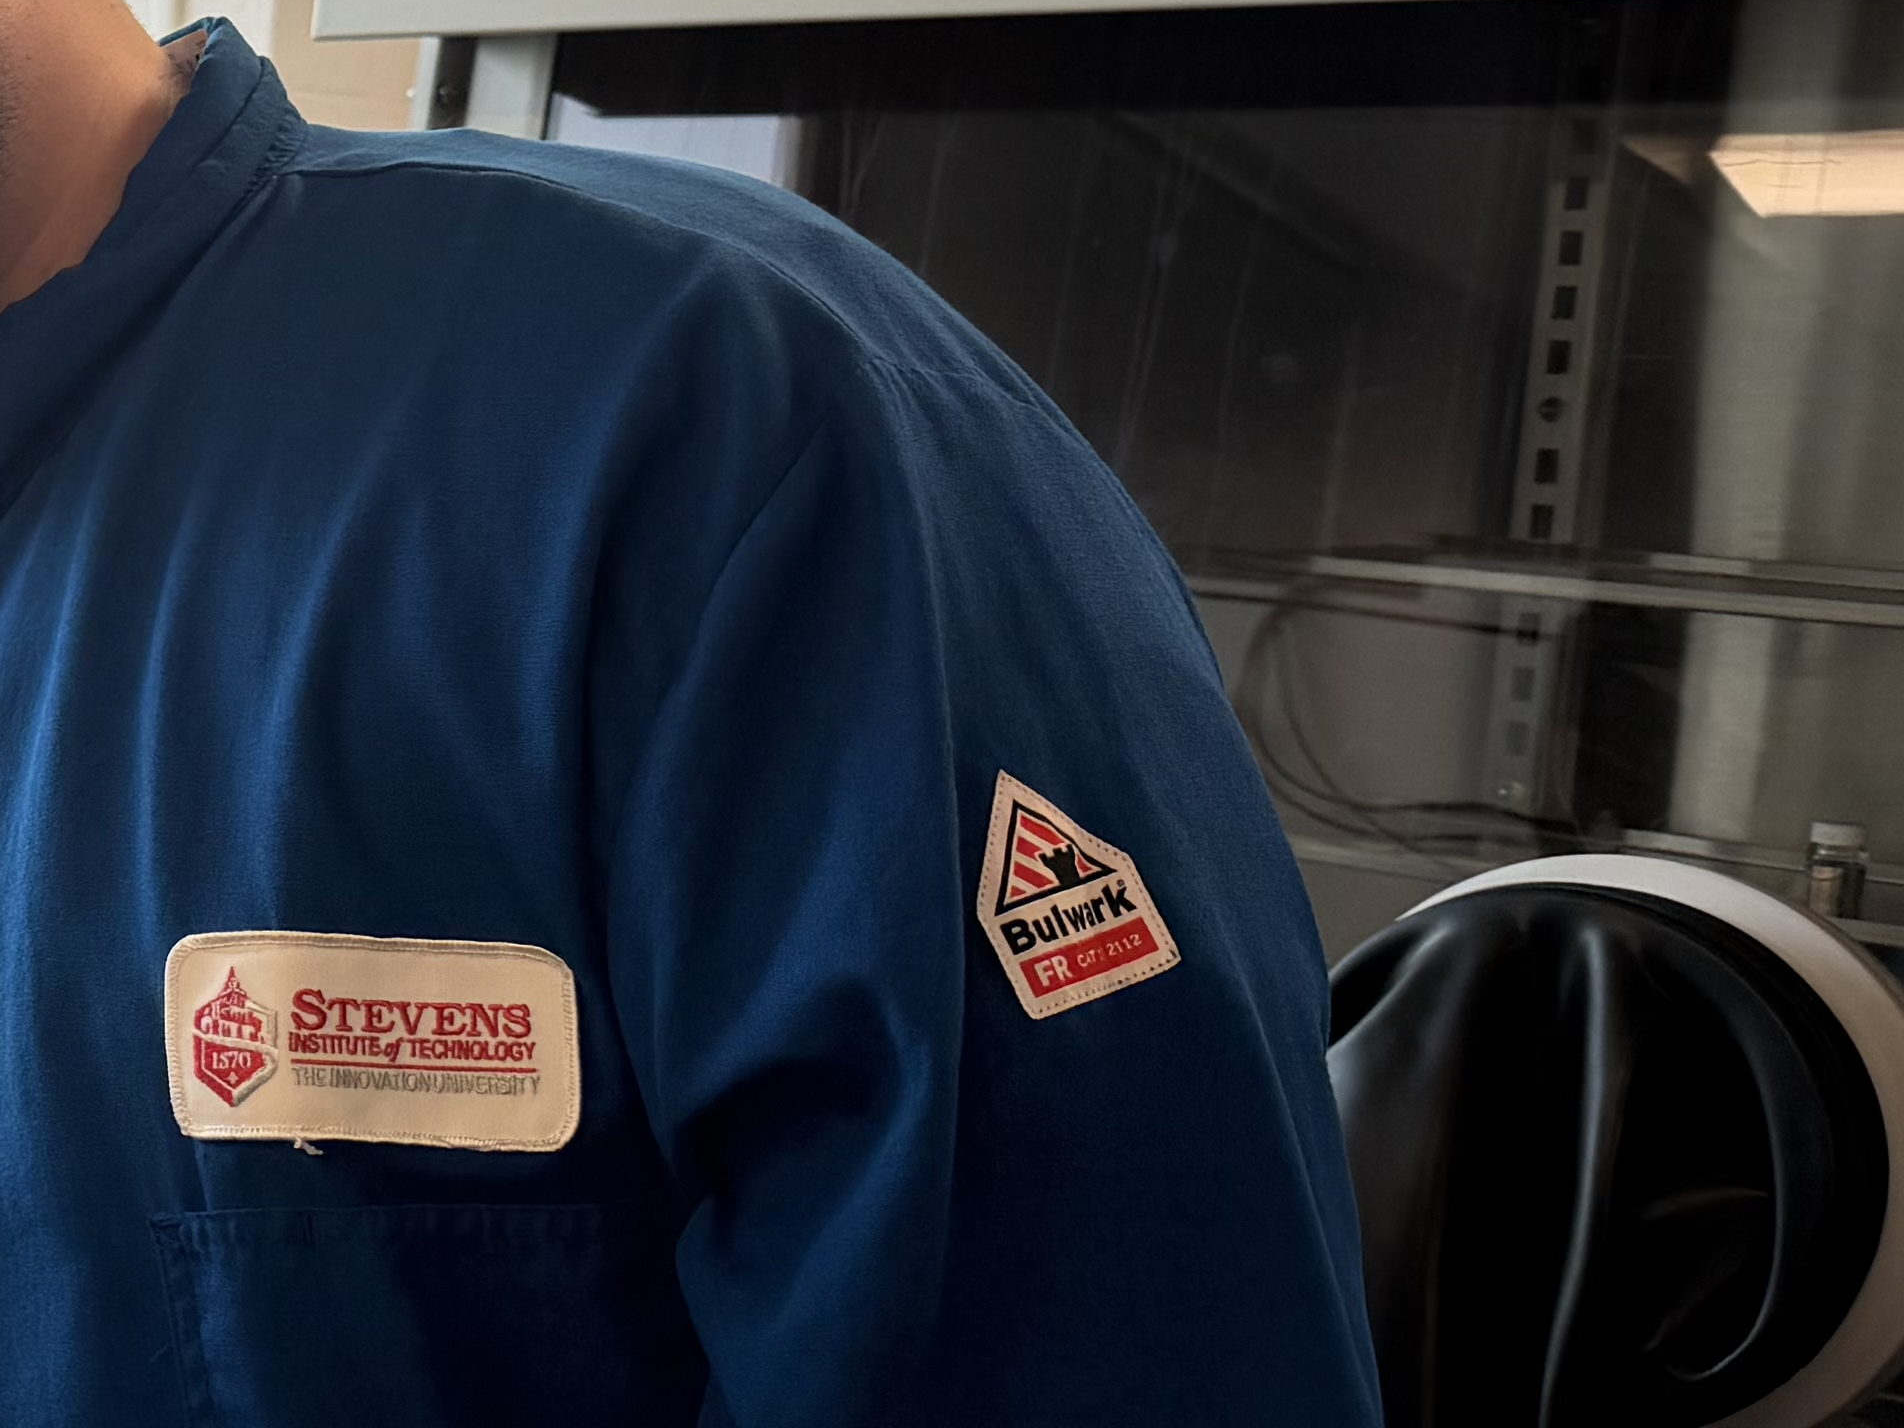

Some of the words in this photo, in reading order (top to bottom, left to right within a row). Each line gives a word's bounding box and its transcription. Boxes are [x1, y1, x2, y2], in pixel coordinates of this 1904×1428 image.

[999, 883, 1138, 956] Bulwark
[1034, 955, 1073, 987] FR
[1107, 933, 1143, 957] 2112
[290, 988, 532, 1039] STEVENS
[288, 1031, 382, 1057] INSTITUTE
[381, 1036, 404, 1063] of
[404, 1038, 537, 1063] TECHNOLOGY
[291, 1066, 326, 1088] THE
[328, 1067, 433, 1093] INNOVATION
[433, 1074, 541, 1097] UNIVERSITY
